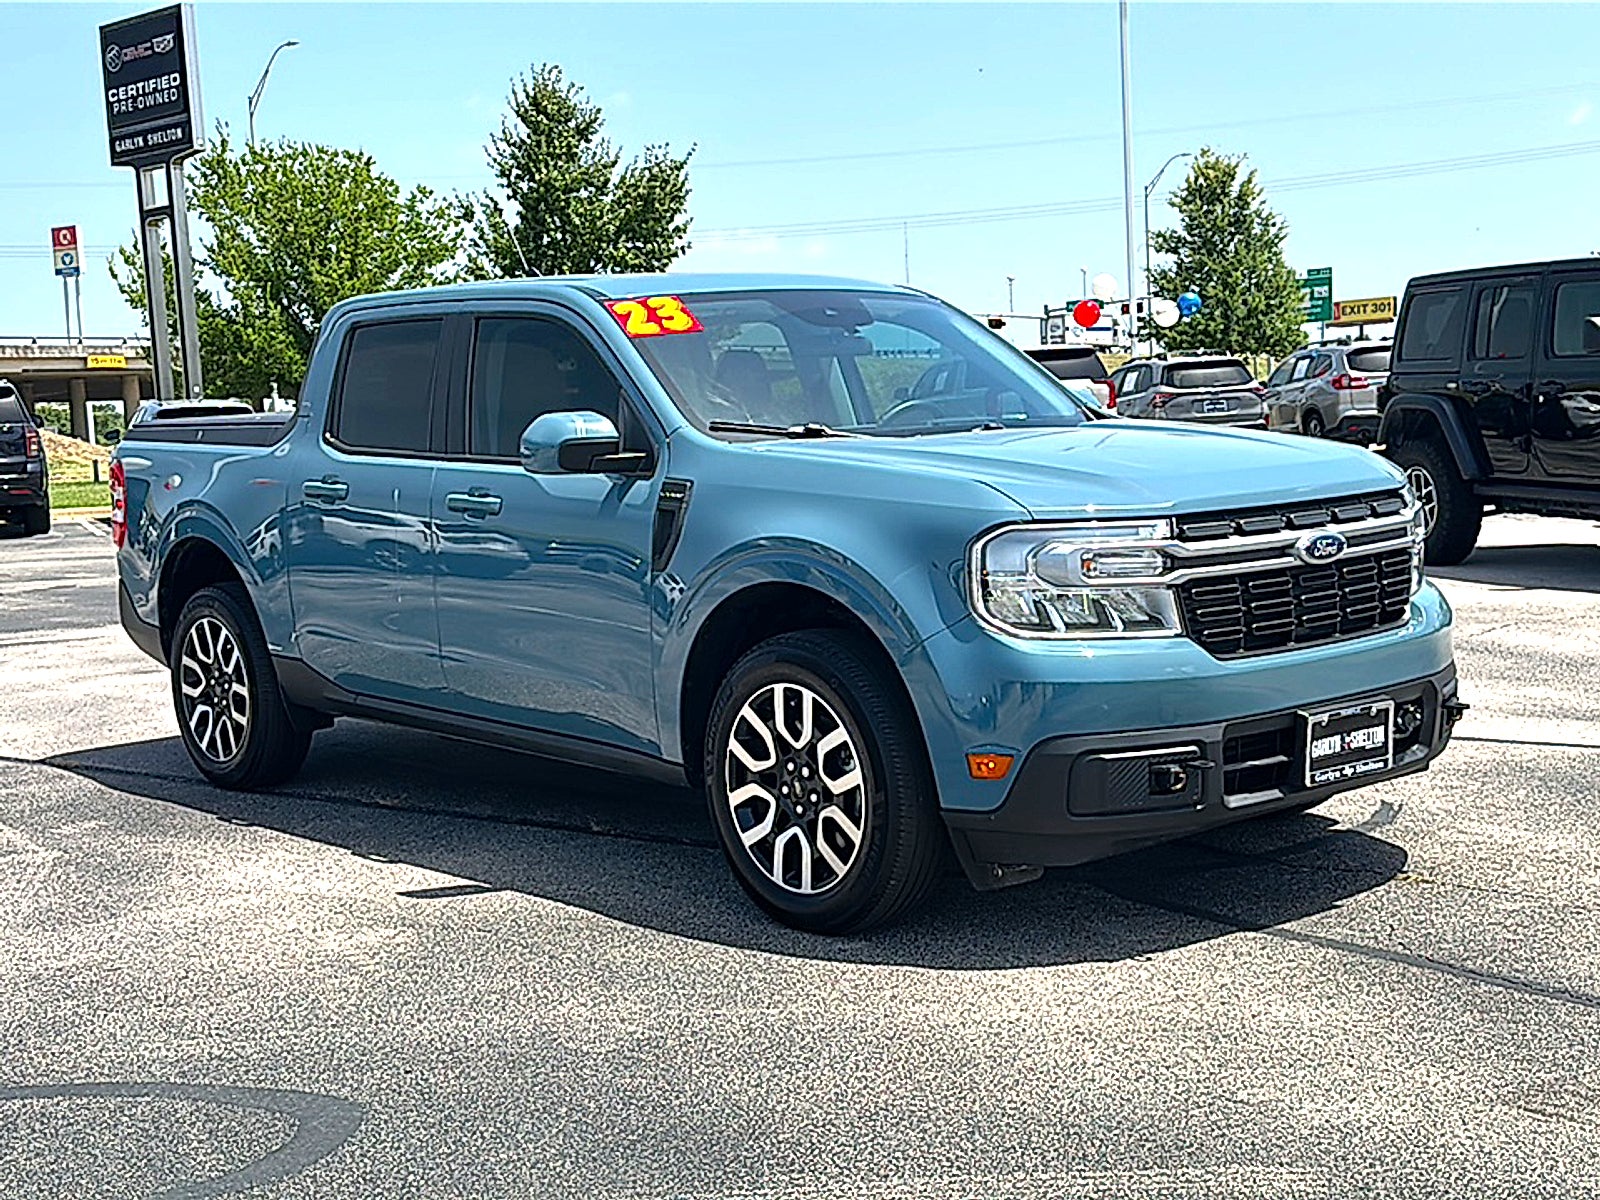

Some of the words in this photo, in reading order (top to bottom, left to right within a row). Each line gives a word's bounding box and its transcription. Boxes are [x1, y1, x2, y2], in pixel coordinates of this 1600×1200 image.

[108, 73, 180, 102] CERTIFIED
[113, 88, 177, 115] PRE-OWNED
[115, 136, 144, 152] GARLYN
[147, 127, 182, 146] SHELTON
[612, 296, 693, 334] 23
[1341, 303, 1369, 316] EXIT
[1371, 301, 1392, 313] 301
[1313, 539, 1338, 557] Ford
[1312, 735, 1341, 758] GARLYN
[1350, 725, 1385, 750] SHELTON
